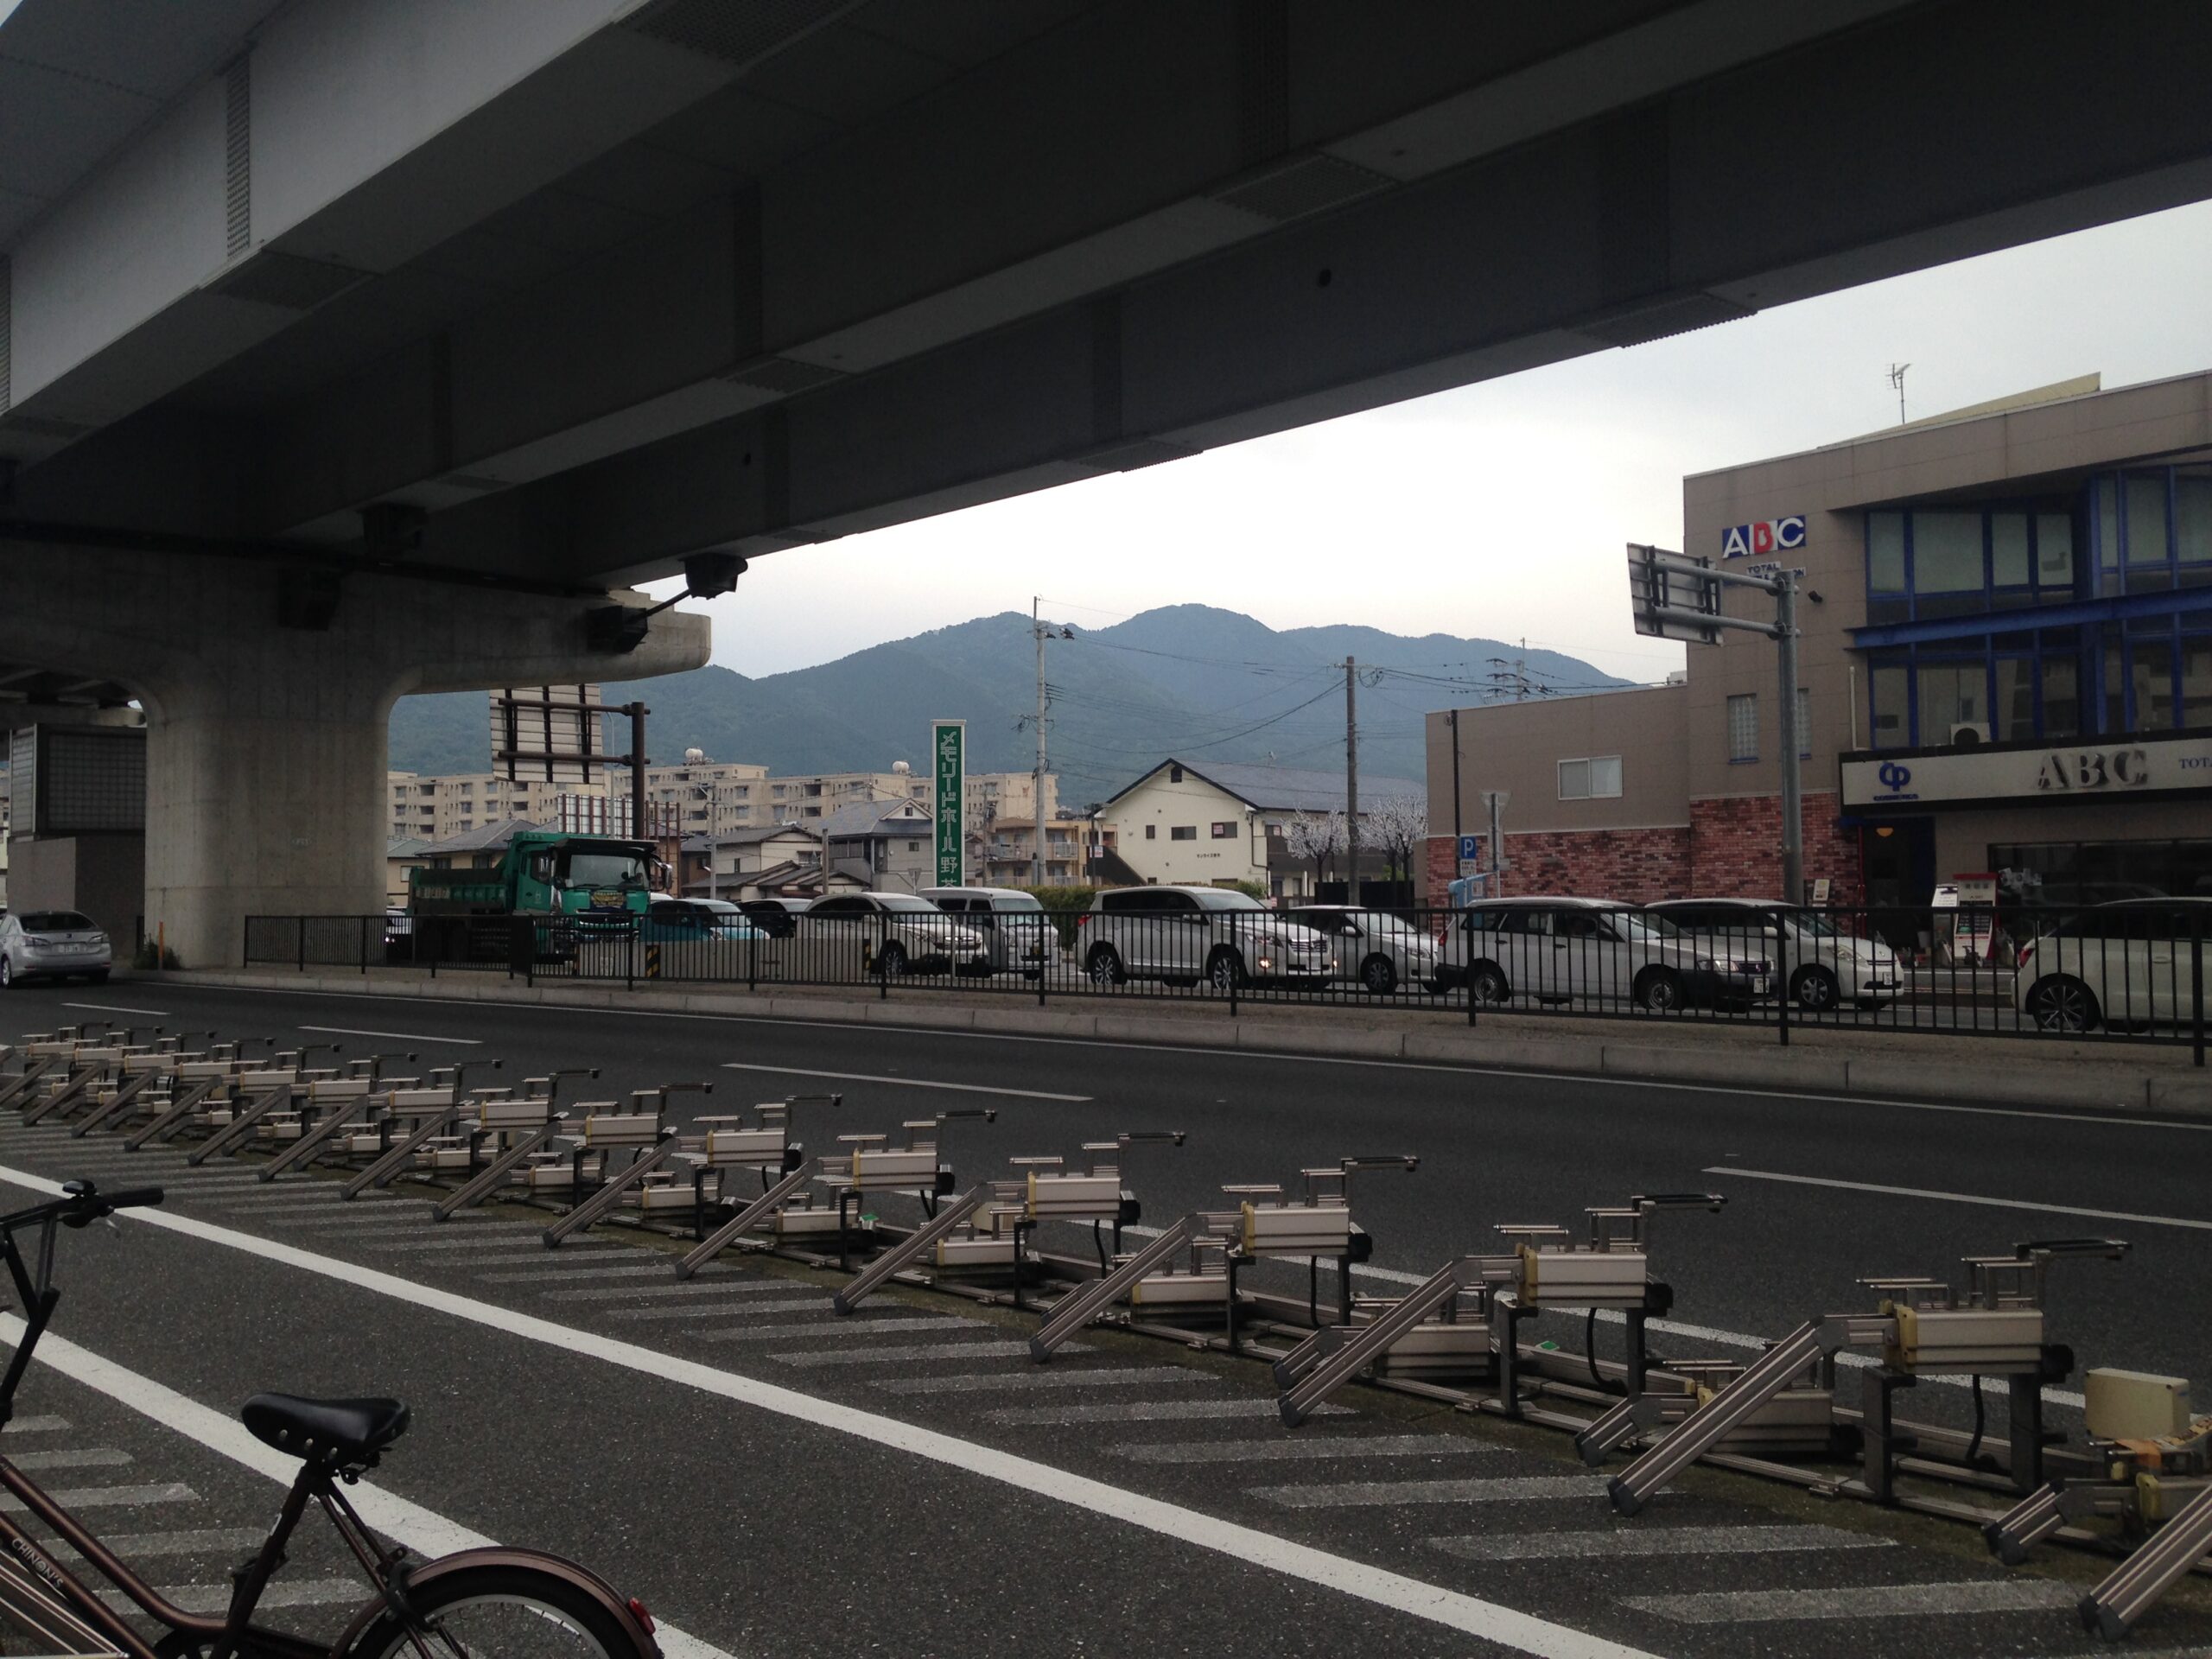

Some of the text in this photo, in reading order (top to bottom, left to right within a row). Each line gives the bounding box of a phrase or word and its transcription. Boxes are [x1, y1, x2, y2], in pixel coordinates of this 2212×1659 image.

[1722, 517, 1804, 559] ABC
[1747, 563, 1780, 574] TOTAL
[2036, 749, 2148, 790] ABC
[2178, 756, 2212, 769] TOT
[1465, 839, 1474, 857] P
[11, 1537, 64, 1588] CHINON'S
